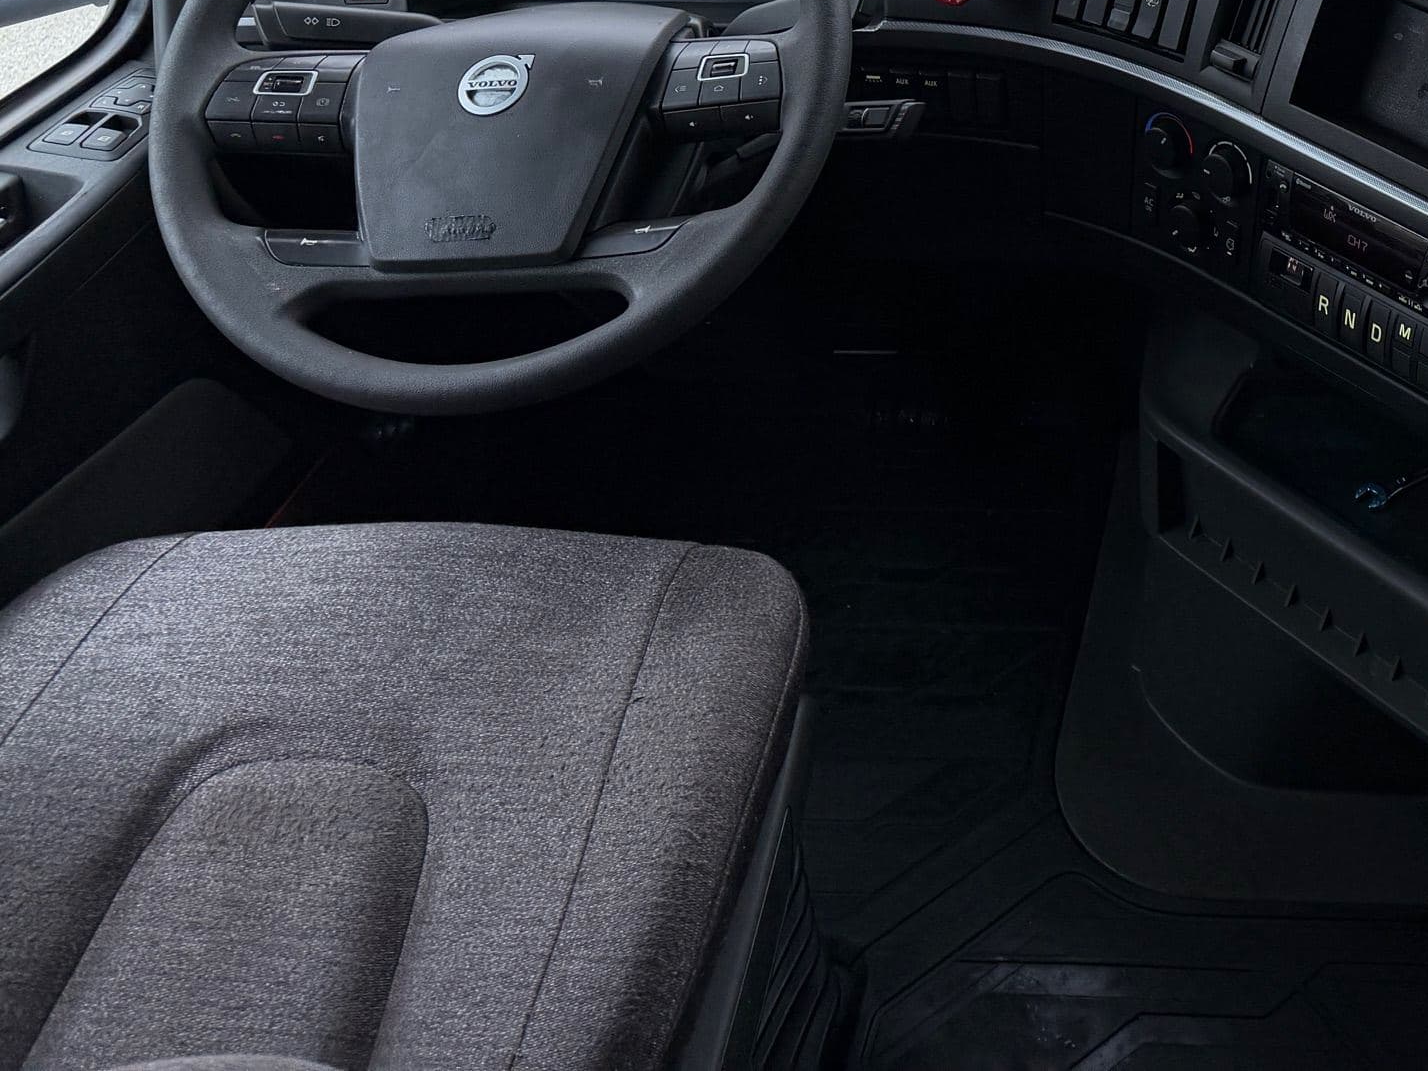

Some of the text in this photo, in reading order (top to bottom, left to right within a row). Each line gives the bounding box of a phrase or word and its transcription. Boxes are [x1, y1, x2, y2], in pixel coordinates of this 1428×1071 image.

[467, 79, 518, 89] VOLVO
[1347, 202, 1377, 223] VOLVO
[1318, 294, 1330, 316] R
[1344, 309, 1356, 330] N
[1370, 322, 1382, 343] D
[1399, 323, 1412, 341] M
